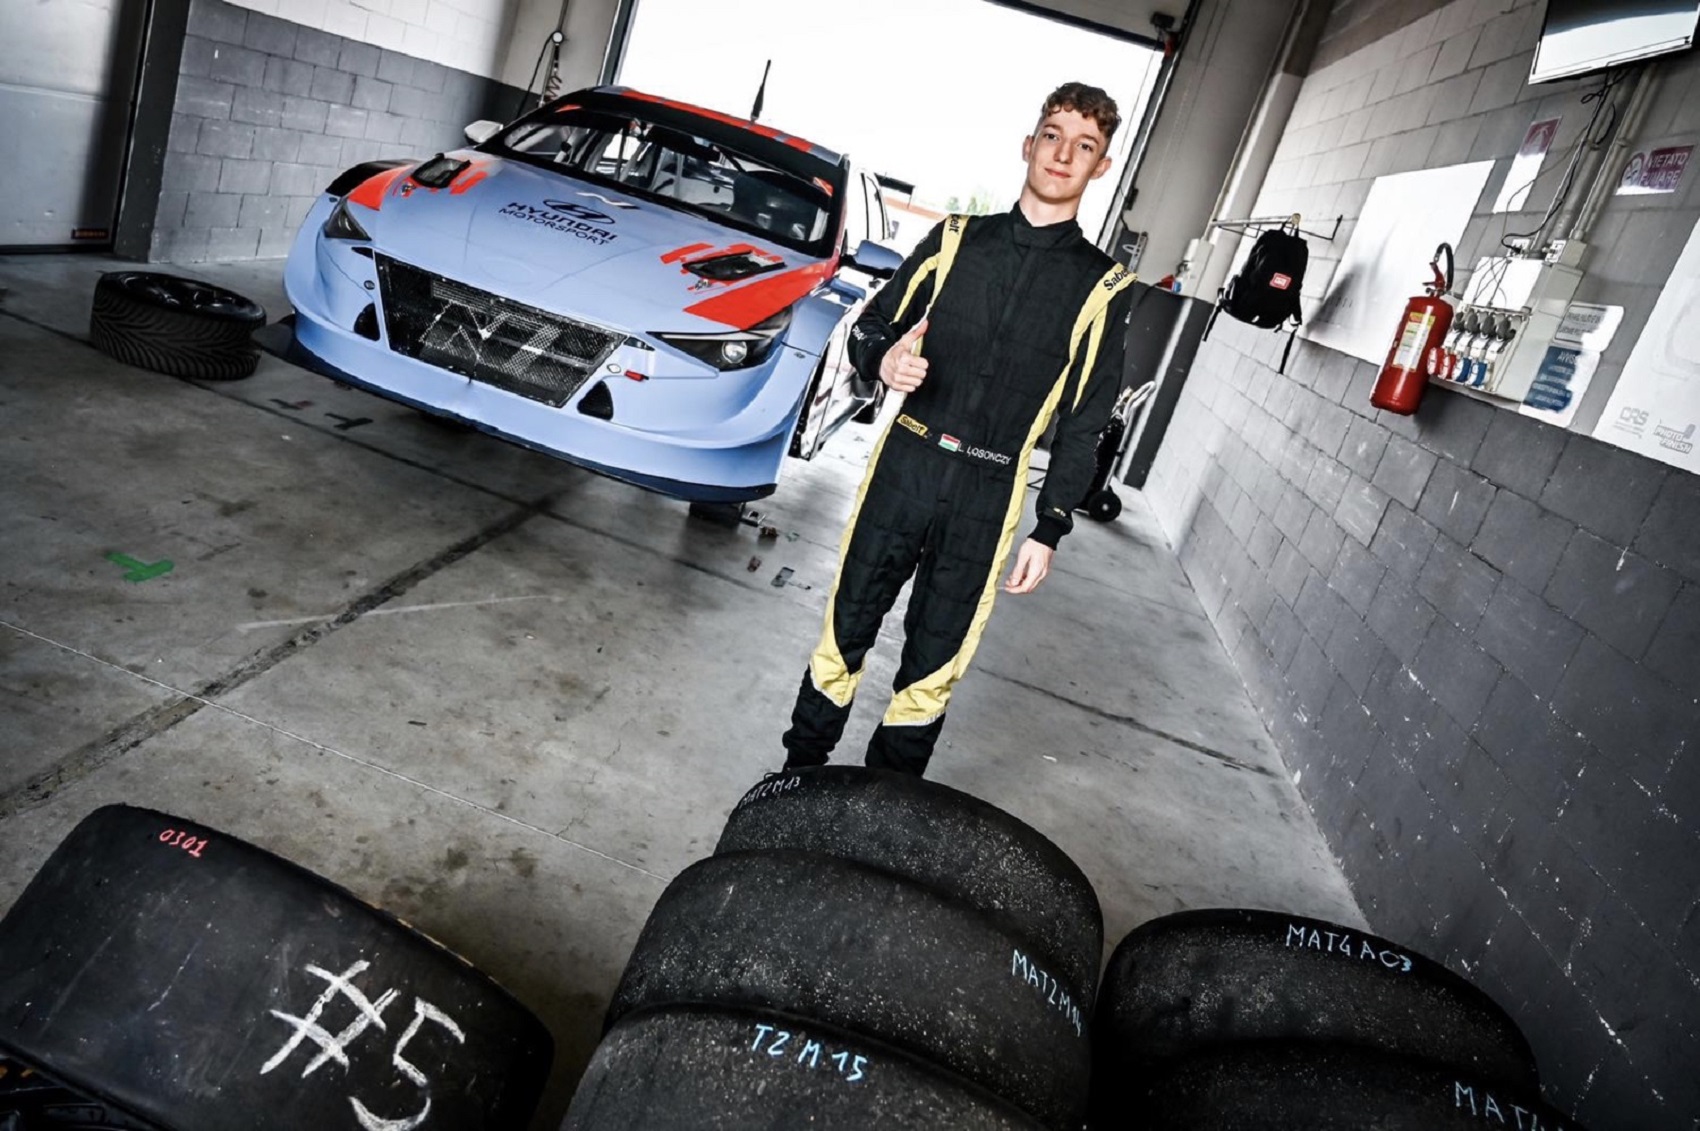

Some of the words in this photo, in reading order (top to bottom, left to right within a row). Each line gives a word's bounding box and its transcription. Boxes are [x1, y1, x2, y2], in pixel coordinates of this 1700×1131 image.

[498, 208, 609, 246] MOTORSPORT
[507, 202, 618, 241] HYUNDAI
[966, 445, 1012, 465] LOSONCZY
[259, 958, 466, 1131] #5
